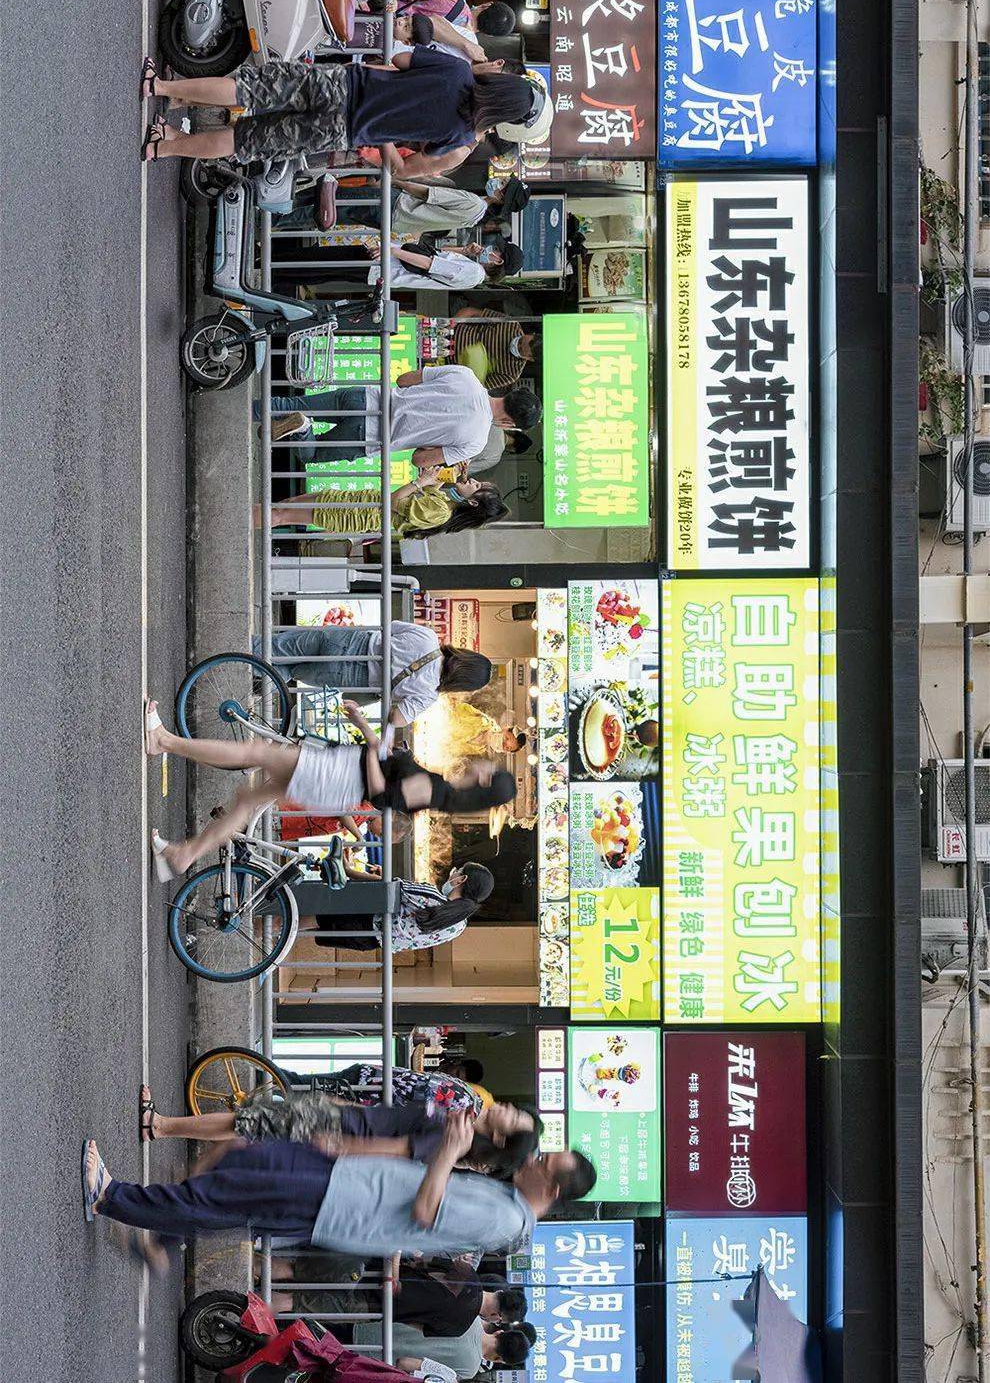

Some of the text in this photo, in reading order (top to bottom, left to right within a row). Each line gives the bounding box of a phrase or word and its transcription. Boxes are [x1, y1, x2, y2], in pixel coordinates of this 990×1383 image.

[573, 322, 640, 516] 山东杂粮煎饼
[705, 197, 796, 554] 山东杂粮煎饼
[677, 467, 693, 555] 专业做饼20年
[731, 594, 797, 1013] 自助鲜果刨冰
[678, 851, 705, 1018] 新鲜 绿色 健康
[688, 1073, 699, 1092] 牛排
[688, 1125, 699, 1145] 小吃
[688, 1152, 700, 1172] 饮品
[550, 1232, 626, 1383] 尝相思臭豆
